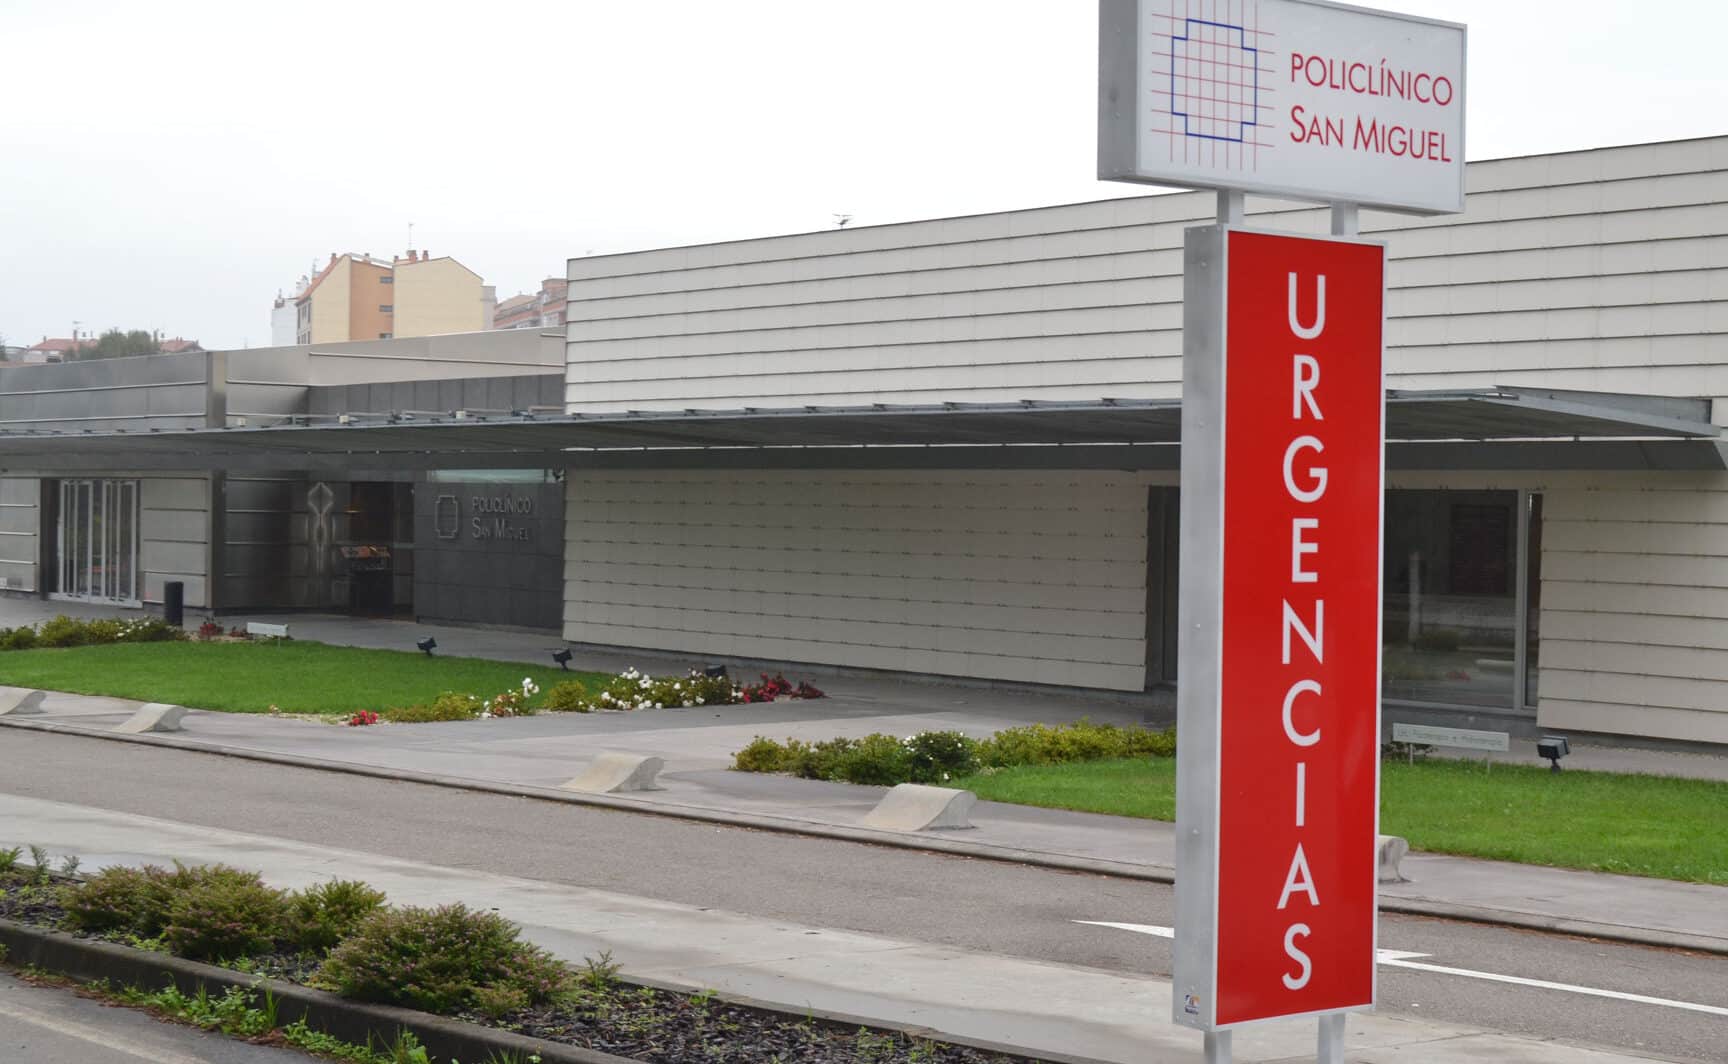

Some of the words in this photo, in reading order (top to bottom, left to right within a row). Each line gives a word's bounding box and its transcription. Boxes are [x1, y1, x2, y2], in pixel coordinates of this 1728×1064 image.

[1290, 53, 1453, 106] POLICLÍNICO
[1290, 105, 1344, 148] SAN
[1353, 115, 1452, 163] MIGUEL
[1277, 271, 1328, 990] URGENCIAS
